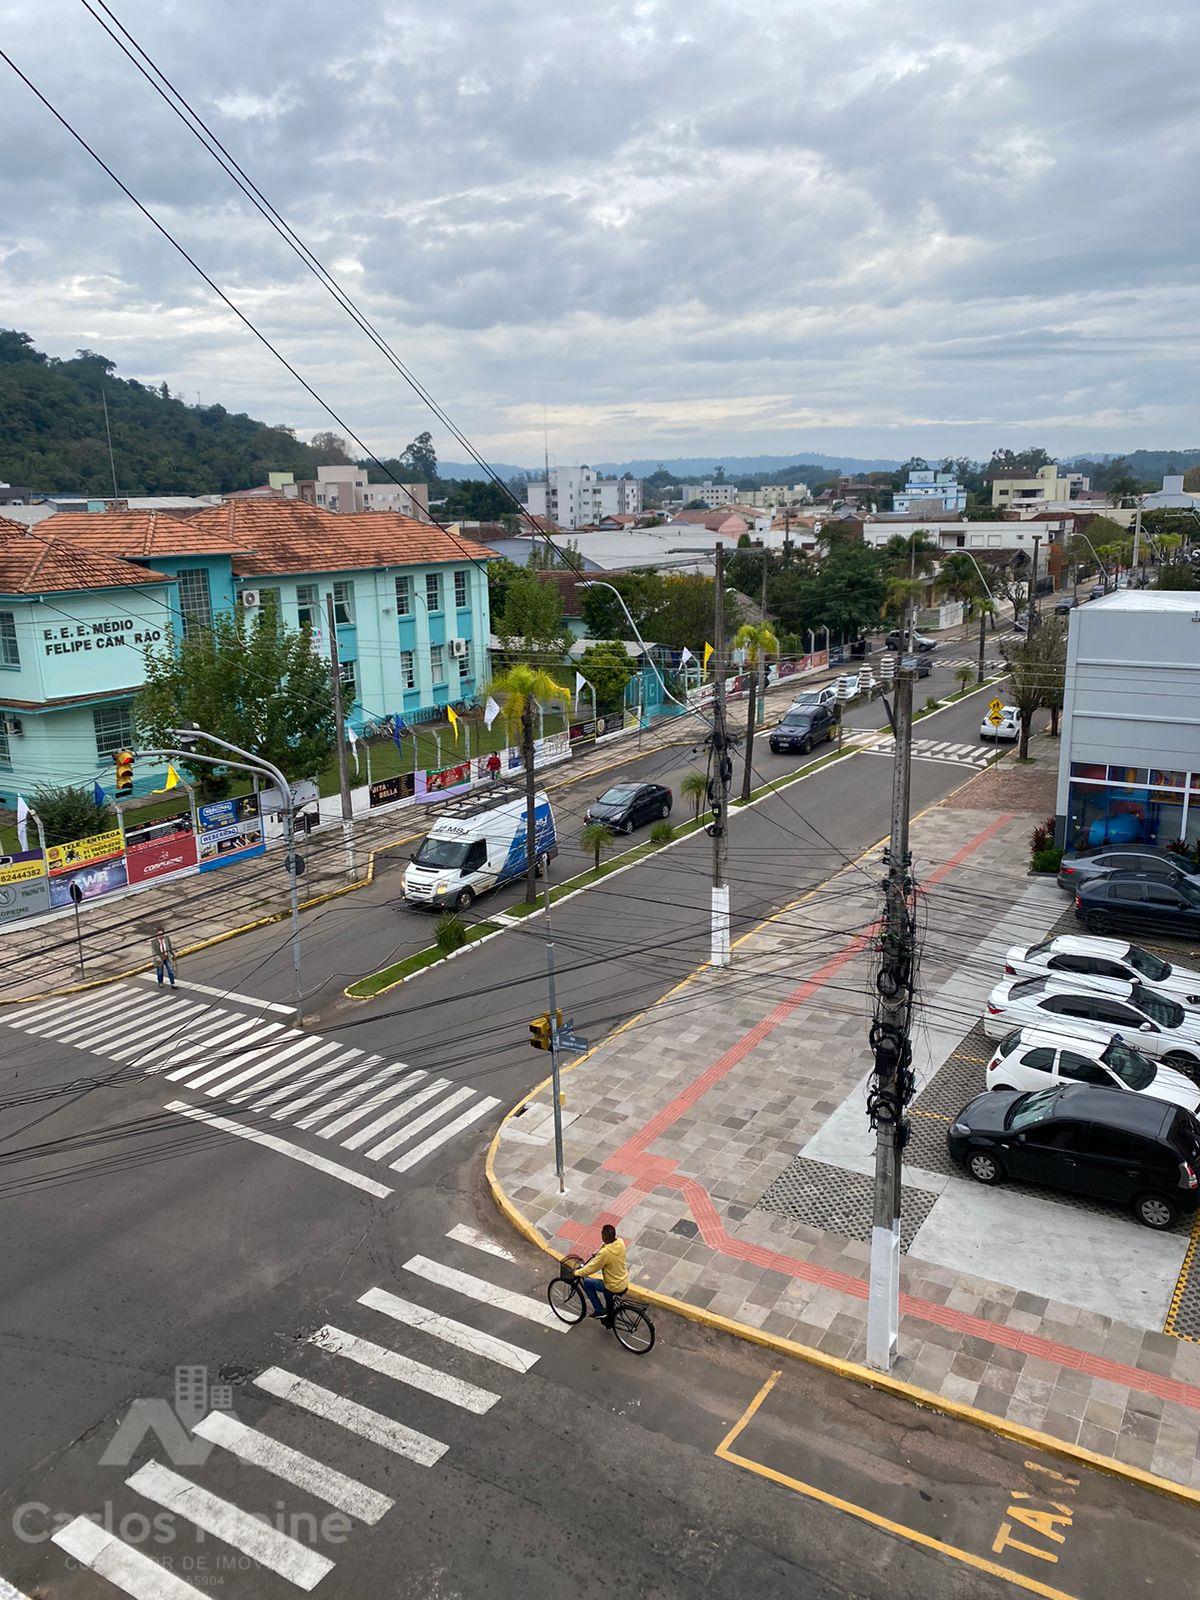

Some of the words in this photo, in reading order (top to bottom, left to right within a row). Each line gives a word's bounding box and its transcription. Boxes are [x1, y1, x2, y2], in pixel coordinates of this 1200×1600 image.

[93, 618, 133, 635] MÉDIO
[45, 640, 92, 655] FELIPE
[379, 788, 398, 799] BELLA
[203, 828, 236, 843] WEBERMAQ
[0, 868, 41, 883] 82444382
